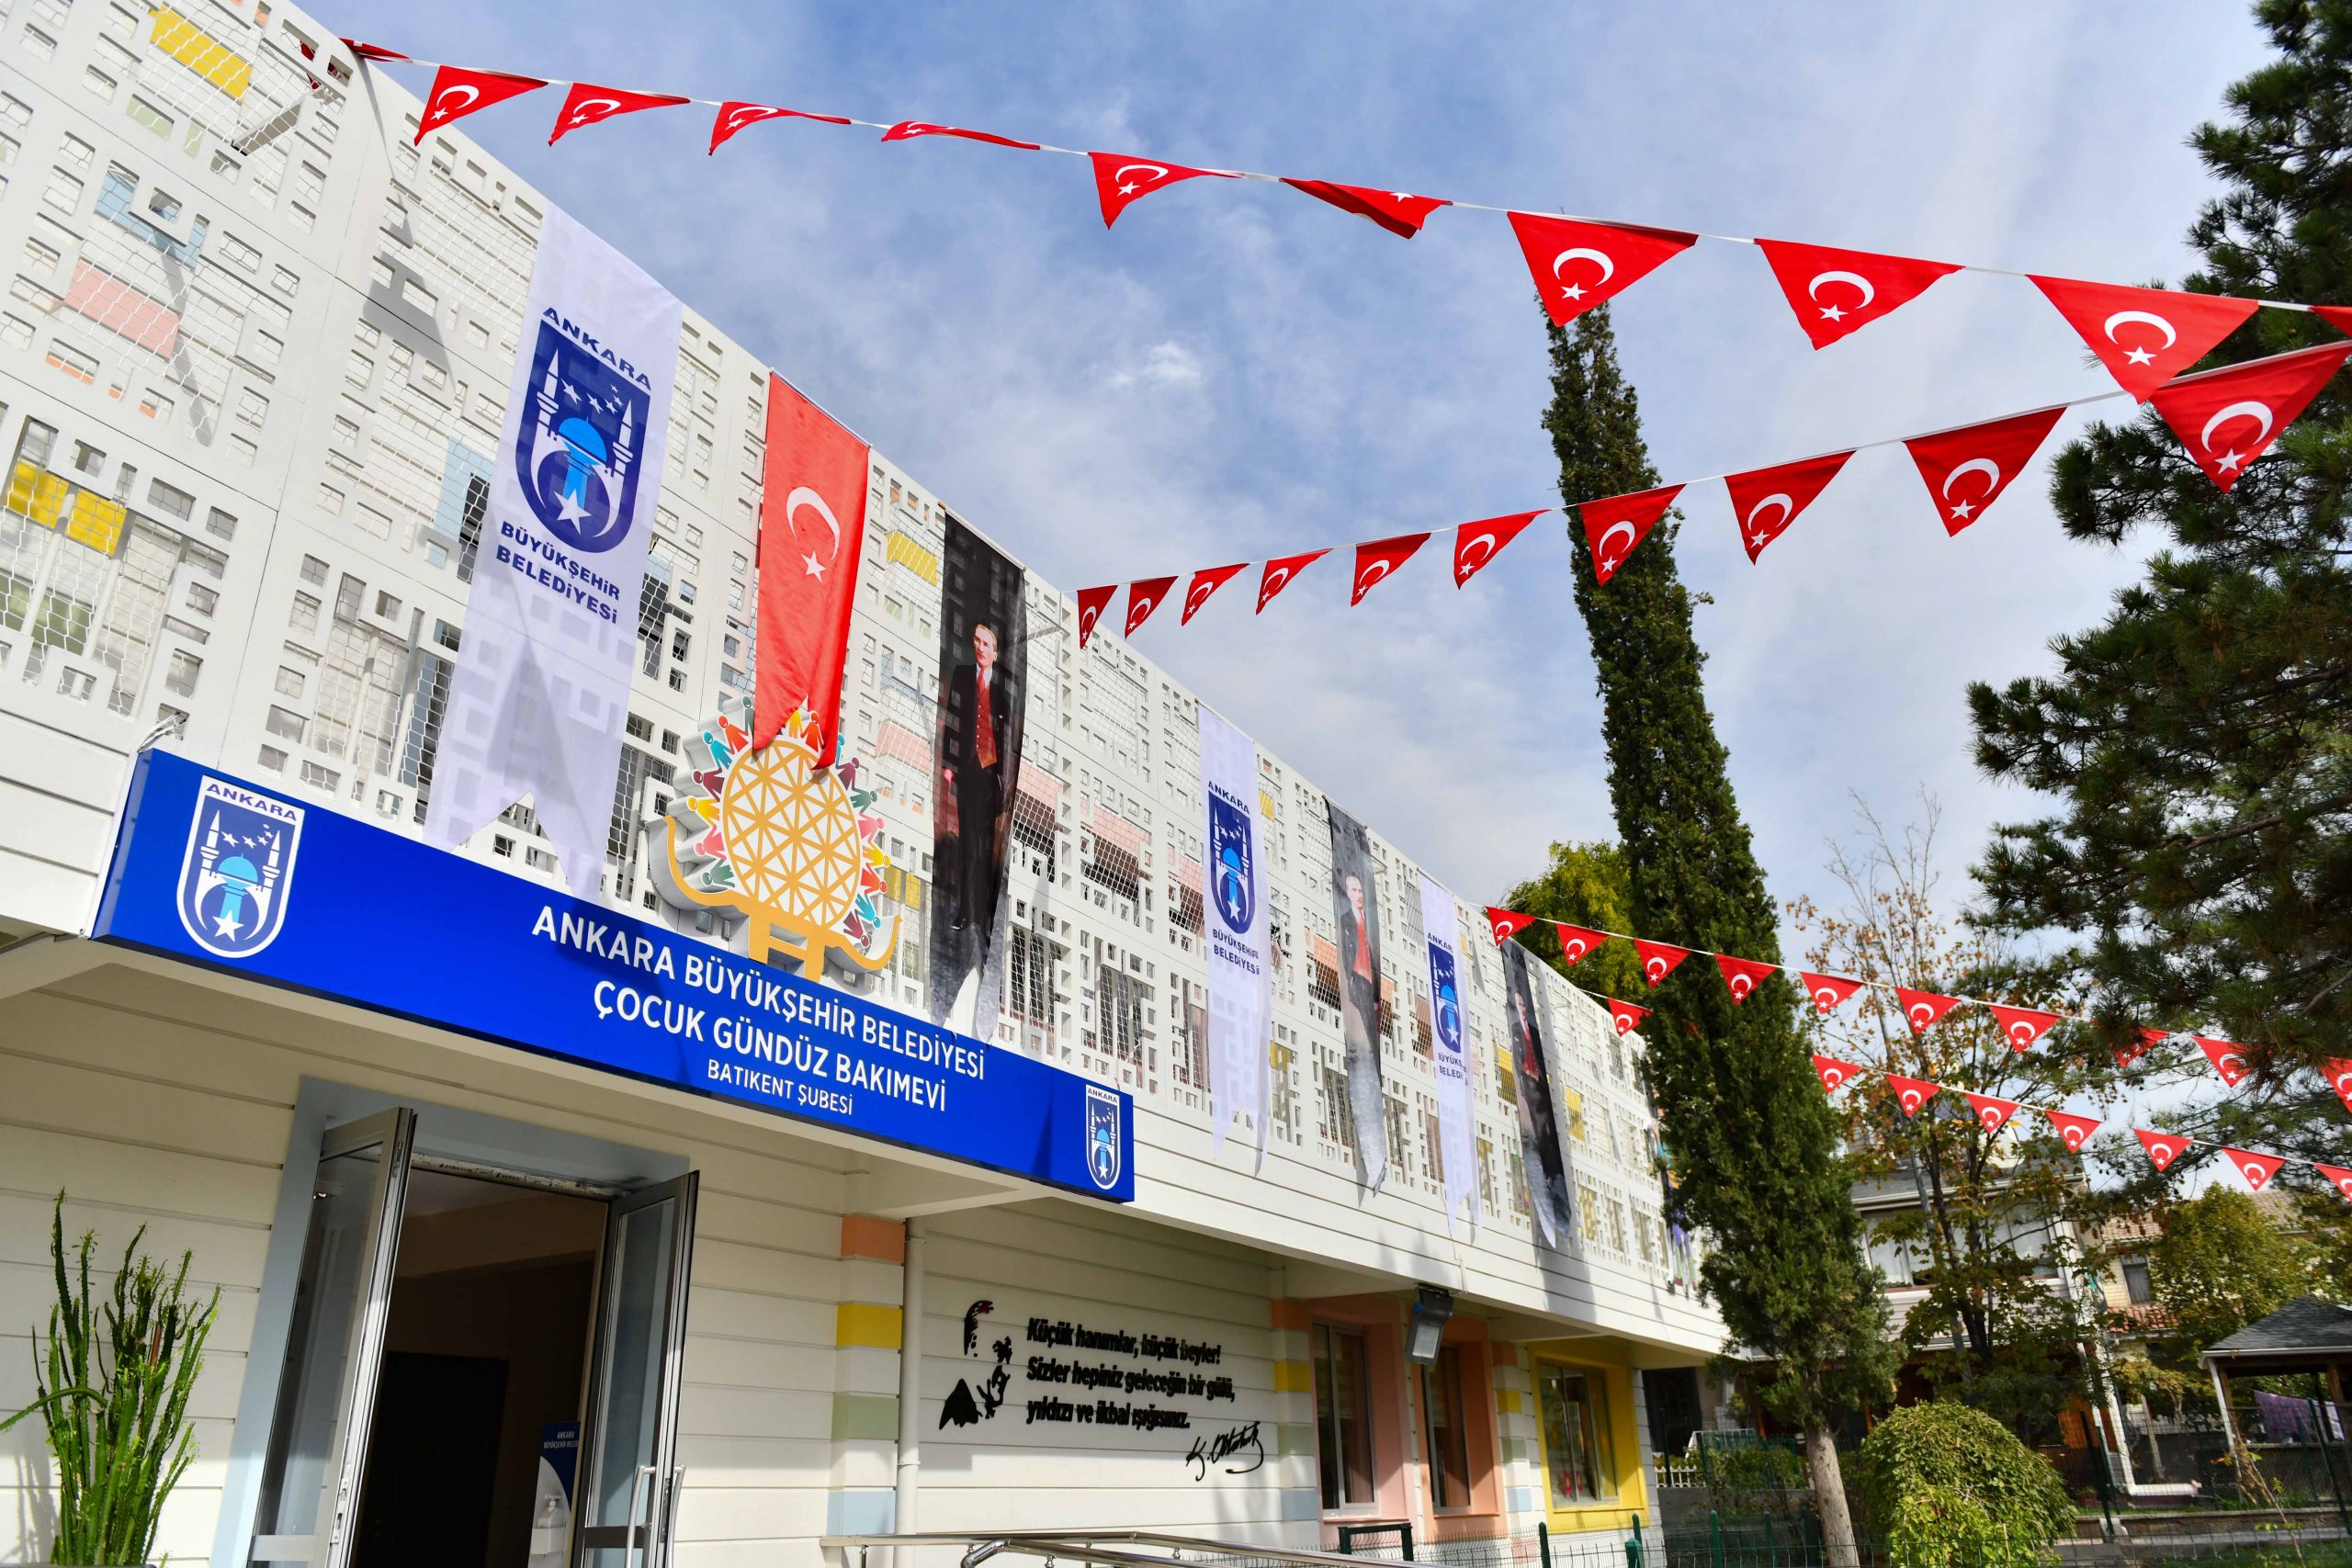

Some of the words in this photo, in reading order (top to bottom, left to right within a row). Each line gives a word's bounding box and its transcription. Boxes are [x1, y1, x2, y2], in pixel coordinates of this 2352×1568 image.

[542, 307, 651, 391] ANKARA
[207, 784, 297, 821] ANKARA
[1208, 781, 1250, 815] ANKARA
[532, 905, 674, 980] ANKARA
[685, 954, 856, 1039] BÜYÜKŞEHİR
[862, 1015, 985, 1080] BELEDİYESİ
[594, 980, 705, 1043] ÇOCUK
[713, 1017, 828, 1077] GÜNDÜZ
[837, 1055, 946, 1112] BAKIMEVİ
[707, 1059, 793, 1100] BATIKENT
[798, 1086, 854, 1116] ŞUBESİ
[1088, 1088, 1118, 1103] ANKARA
[1026, 1317, 1074, 1348] Küçük
[1141, 1333, 1180, 1361] küçük
[1180, 1338, 1222, 1366] beyler!
[1026, 1356, 1071, 1382] Sizler
[1071, 1360, 1125, 1390] hepiniz
[1125, 1368, 1187, 1397] geleceğin
[1188, 1373, 1205, 1395] bir
[1077, 1404, 1094, 1423] ve
[1095, 1400, 1131, 1425] ikbal
